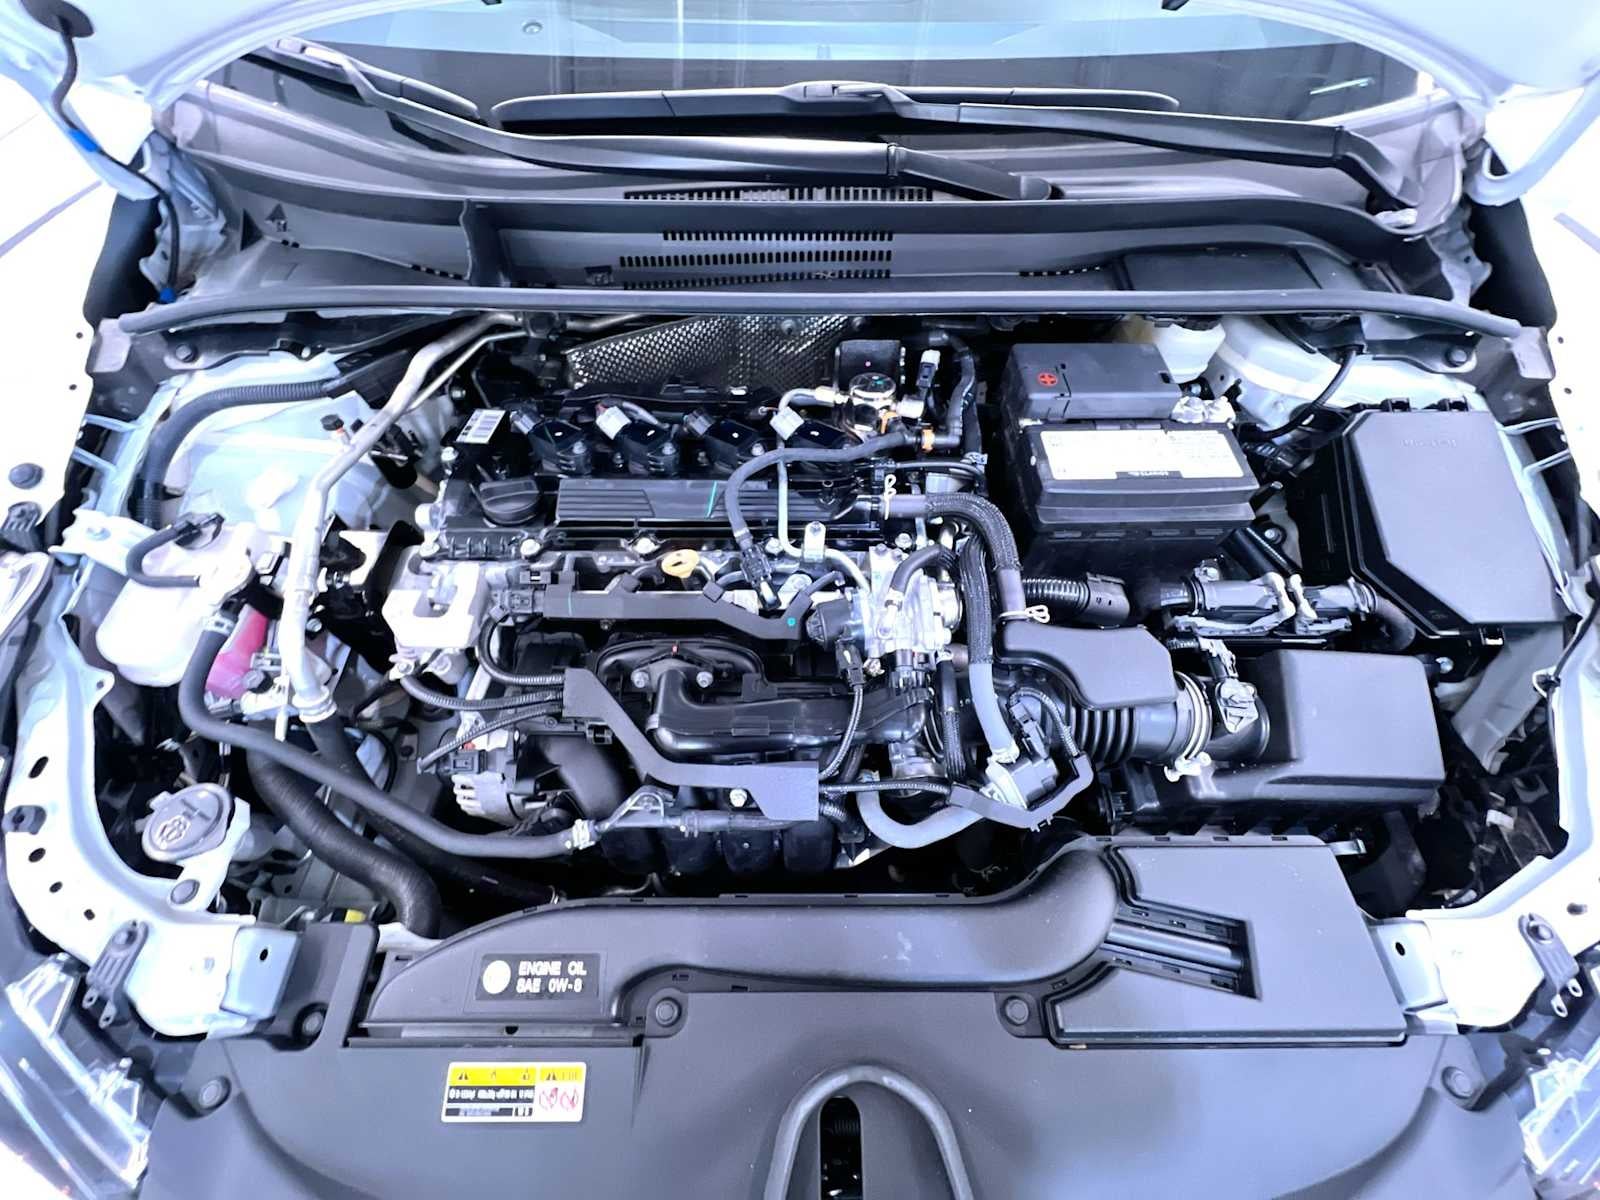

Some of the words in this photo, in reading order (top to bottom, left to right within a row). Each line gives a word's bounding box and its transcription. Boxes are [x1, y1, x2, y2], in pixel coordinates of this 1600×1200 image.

[518, 960, 562, 976] ENGINE
[567, 960, 587, 976] OIL
[516, 977, 541, 993] SAE
